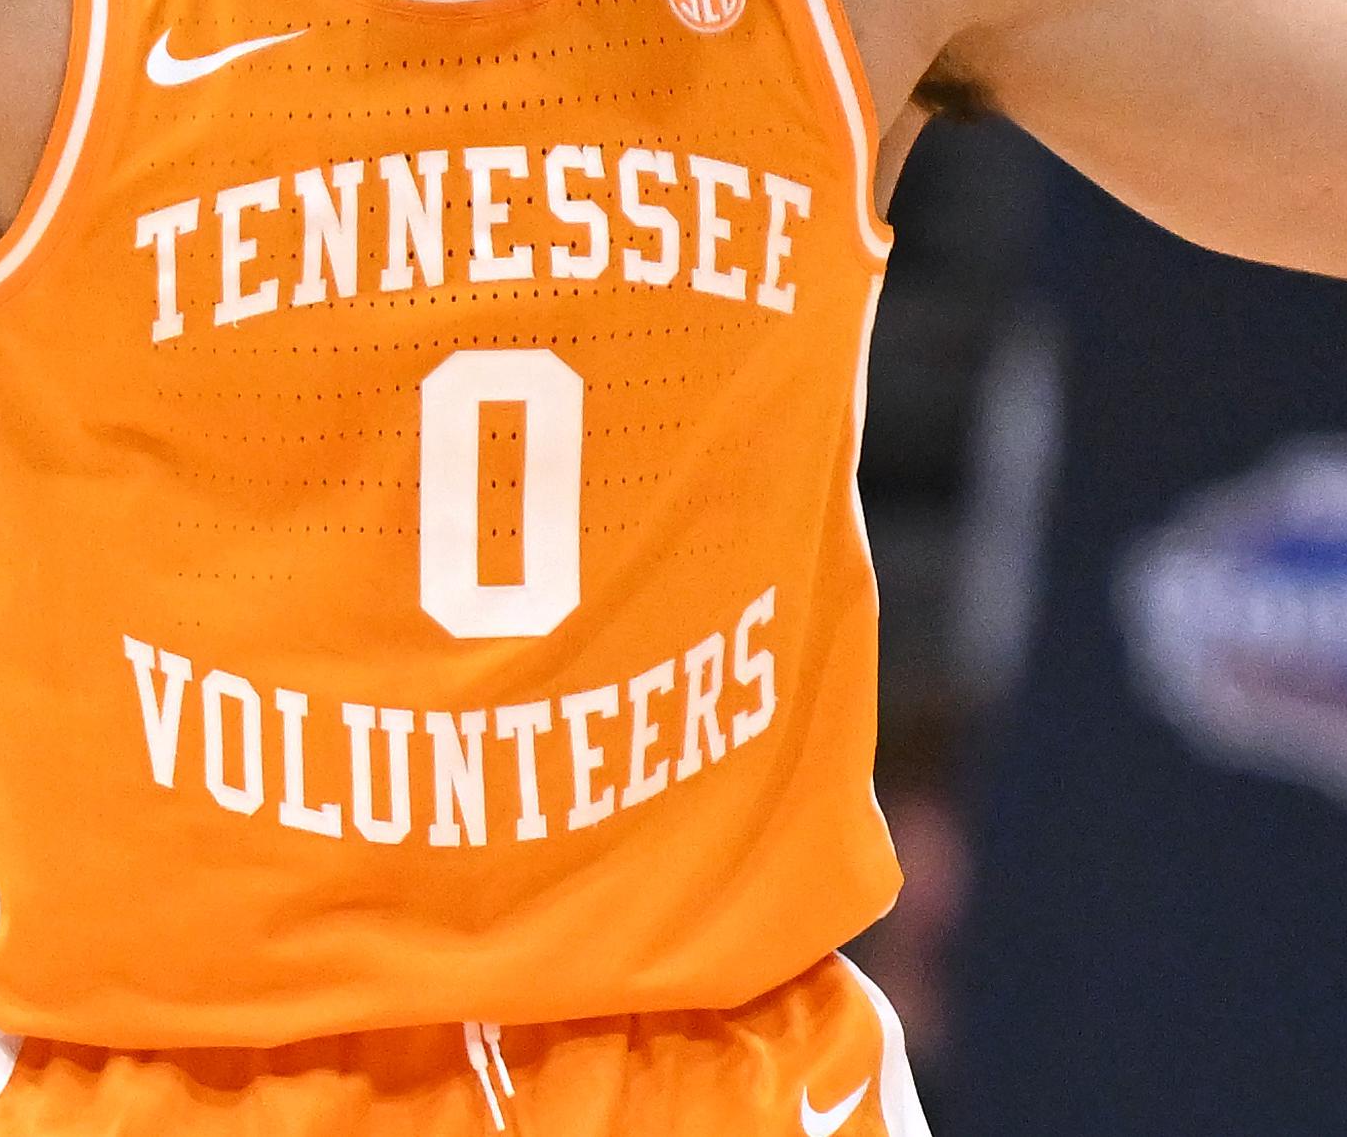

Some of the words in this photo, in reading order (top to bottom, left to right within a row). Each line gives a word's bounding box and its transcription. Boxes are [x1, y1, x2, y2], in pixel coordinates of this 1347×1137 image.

[134, 144, 812, 343] TENNESSEE
[419, 348, 584, 639] 0
[122, 586, 777, 847] VOLUNTEERS
